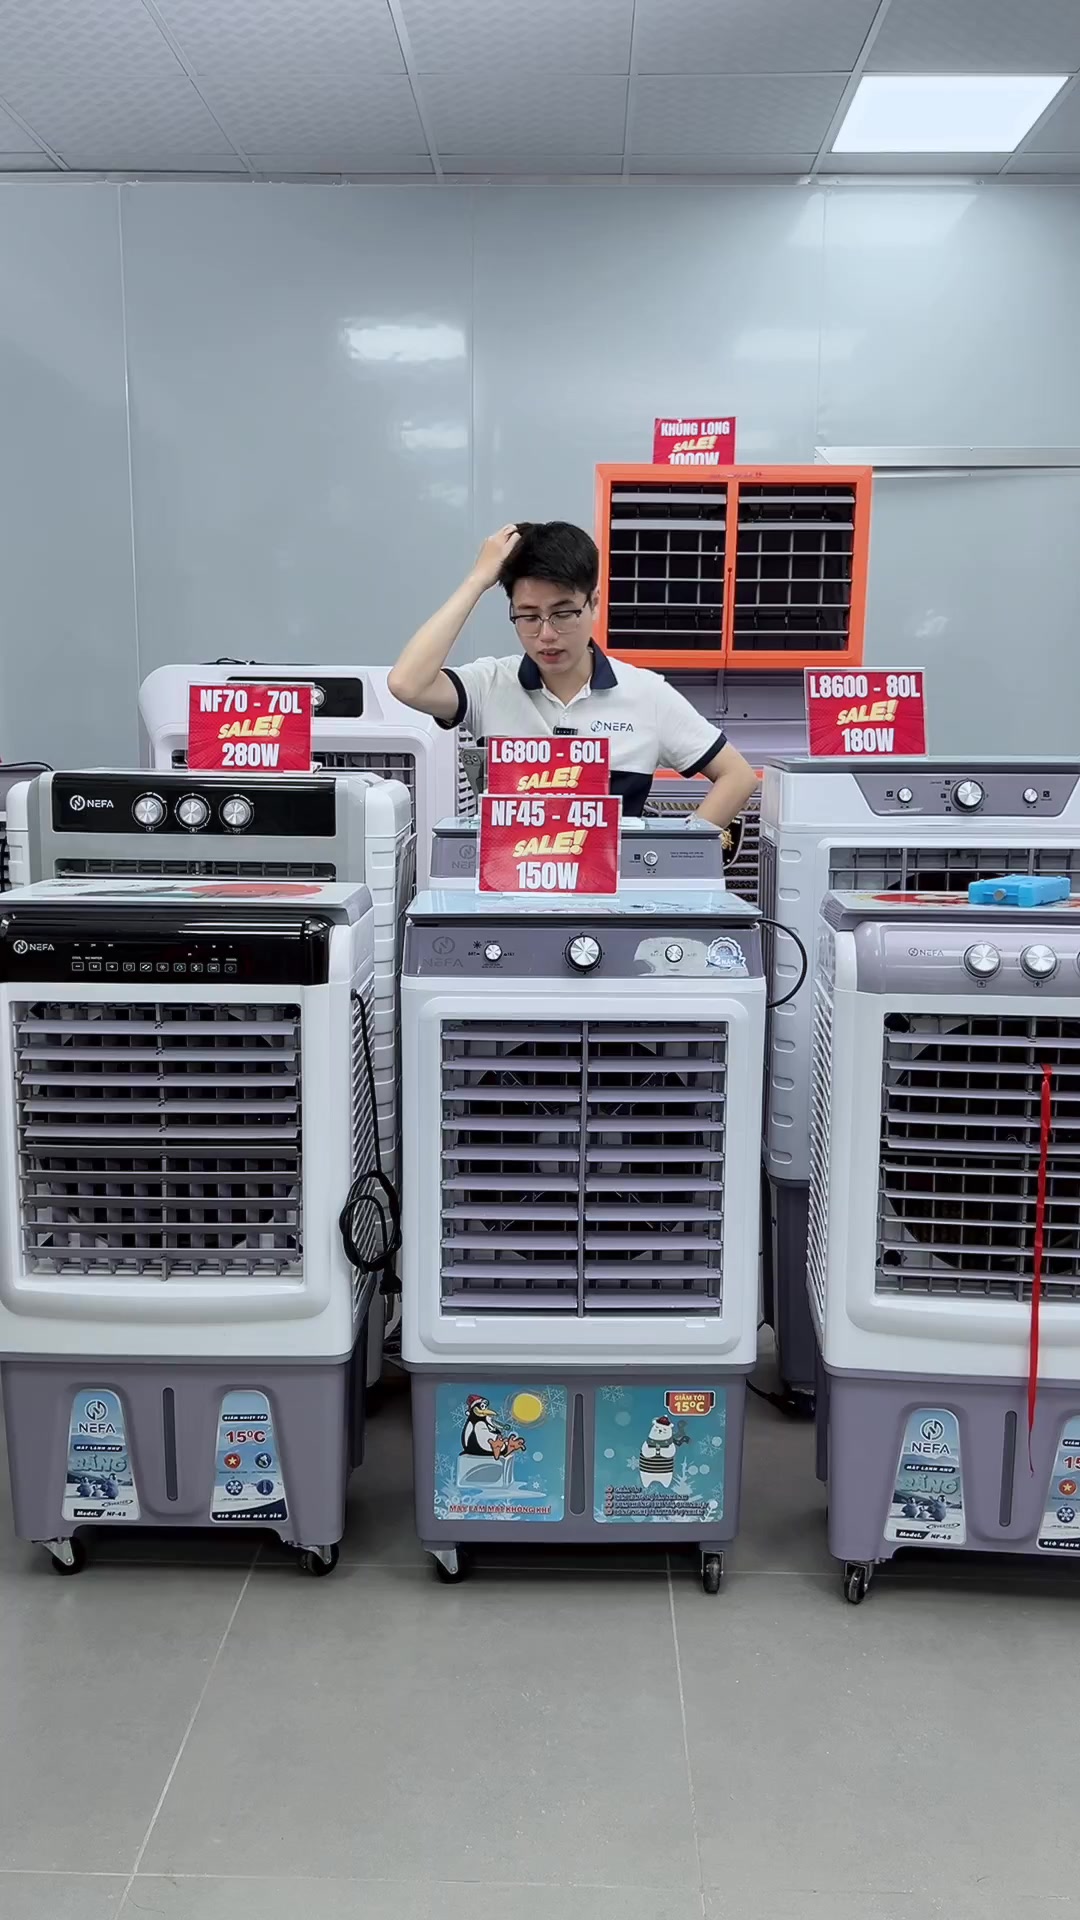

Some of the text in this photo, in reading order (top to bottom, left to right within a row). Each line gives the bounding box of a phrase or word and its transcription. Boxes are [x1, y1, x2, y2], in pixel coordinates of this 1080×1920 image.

[661, 419, 730, 436] KHỦNG LONG
[672, 436, 718, 452] SALE!
[810, 675, 868, 698] L8600
[886, 675, 920, 698] 80L
[200, 689, 248, 713] NF70
[267, 690, 302, 714] 70L
[836, 700, 899, 725] SALE!
[217, 714, 285, 739] SALE!
[604, 722, 634, 732] NEFA
[491, 740, 551, 763] L6800
[570, 740, 605, 763] 60L
[841, 728, 894, 752] 180W
[222, 743, 279, 767] 280W
[516, 765, 583, 791] SALE!
[87, 799, 114, 808] NEFA
[491, 800, 545, 827] NF45
[567, 801, 608, 828] 45L
[512, 829, 588, 858] SALE!
[451, 861, 476, 870] NEF
[516, 861, 579, 890] 150W
[30, 943, 55, 951] NEFA
[919, 949, 944, 957] NEFA
[423, 959, 463, 968] NEFA
[79, 1423, 116, 1433] NEFA
[912, 1442, 951, 1454] NEFA
